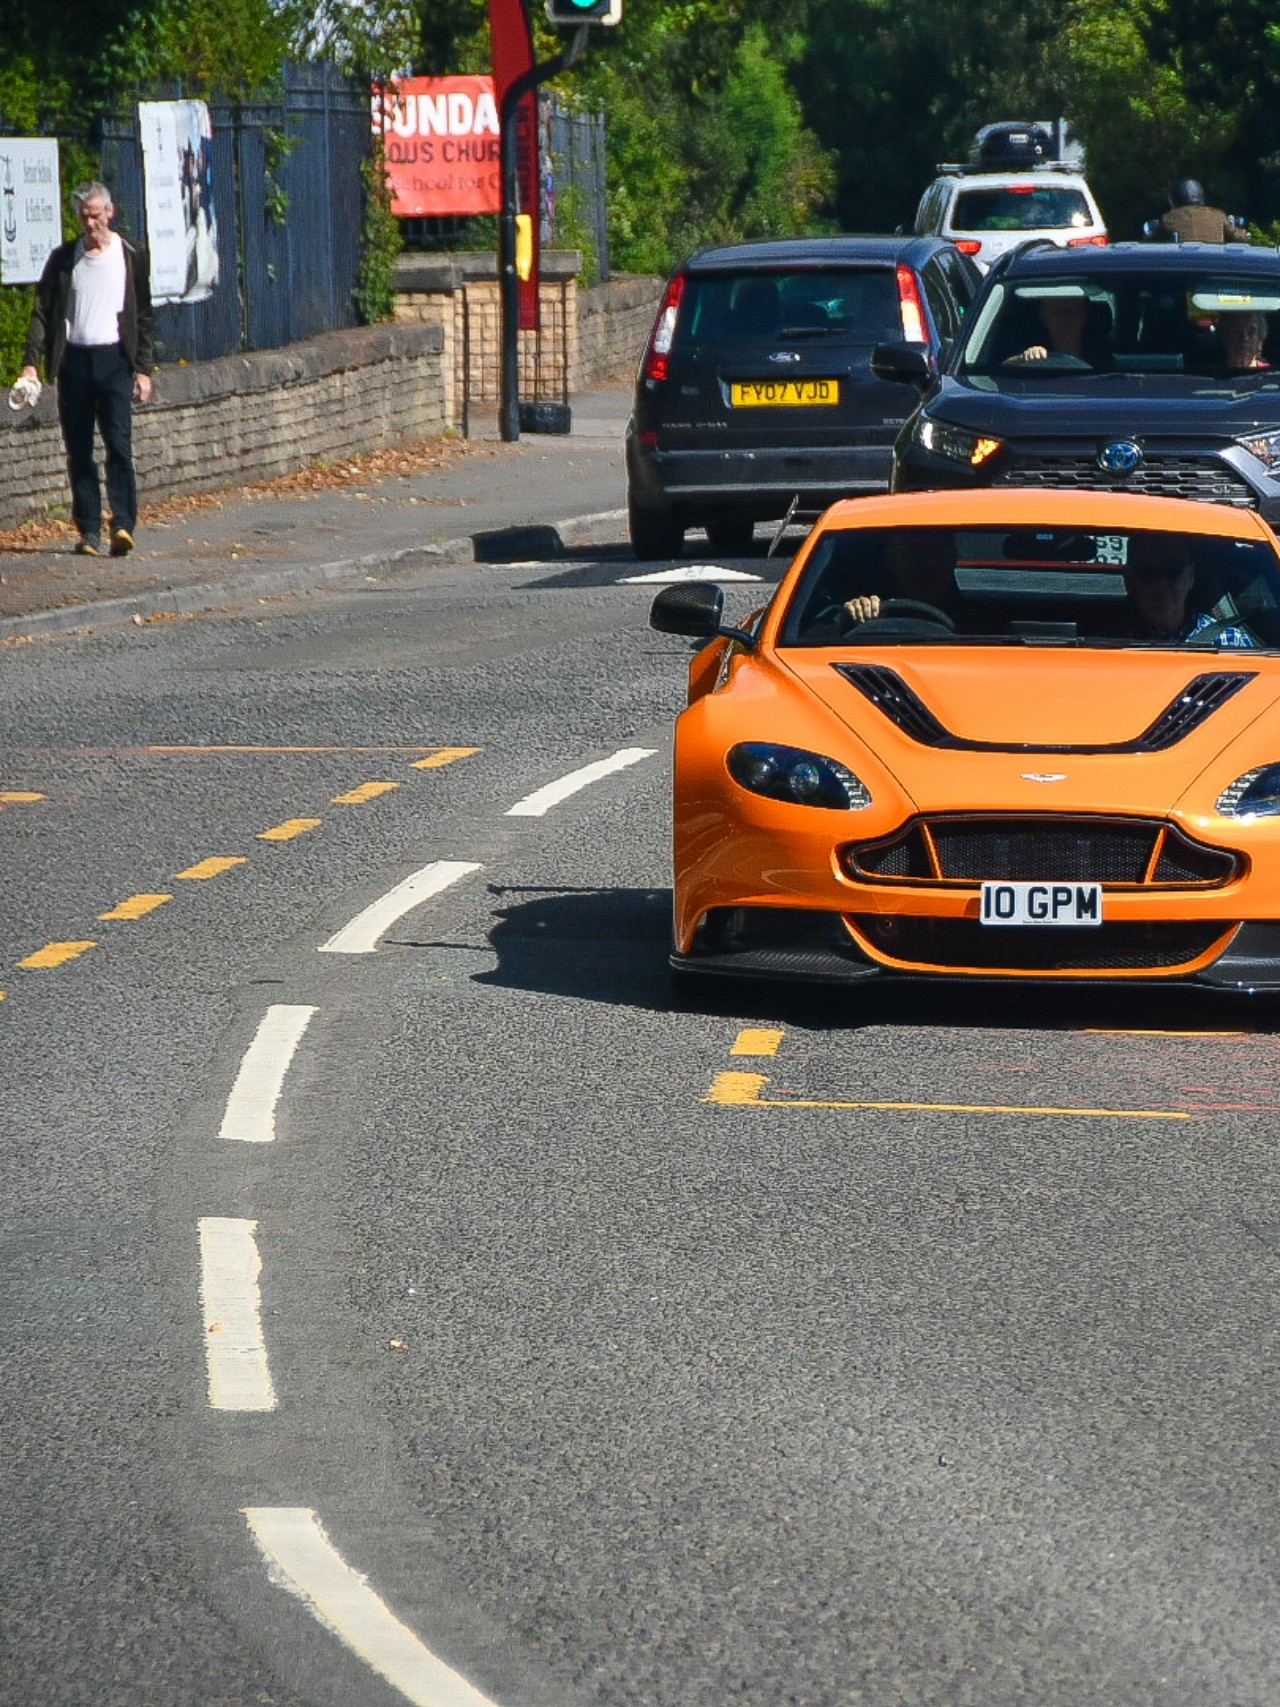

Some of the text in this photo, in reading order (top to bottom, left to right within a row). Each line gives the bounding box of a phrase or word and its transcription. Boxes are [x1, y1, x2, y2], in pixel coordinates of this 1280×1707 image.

[740, 382, 830, 400] FY07 VJD
[984, 886, 1098, 919] 10 GPM
